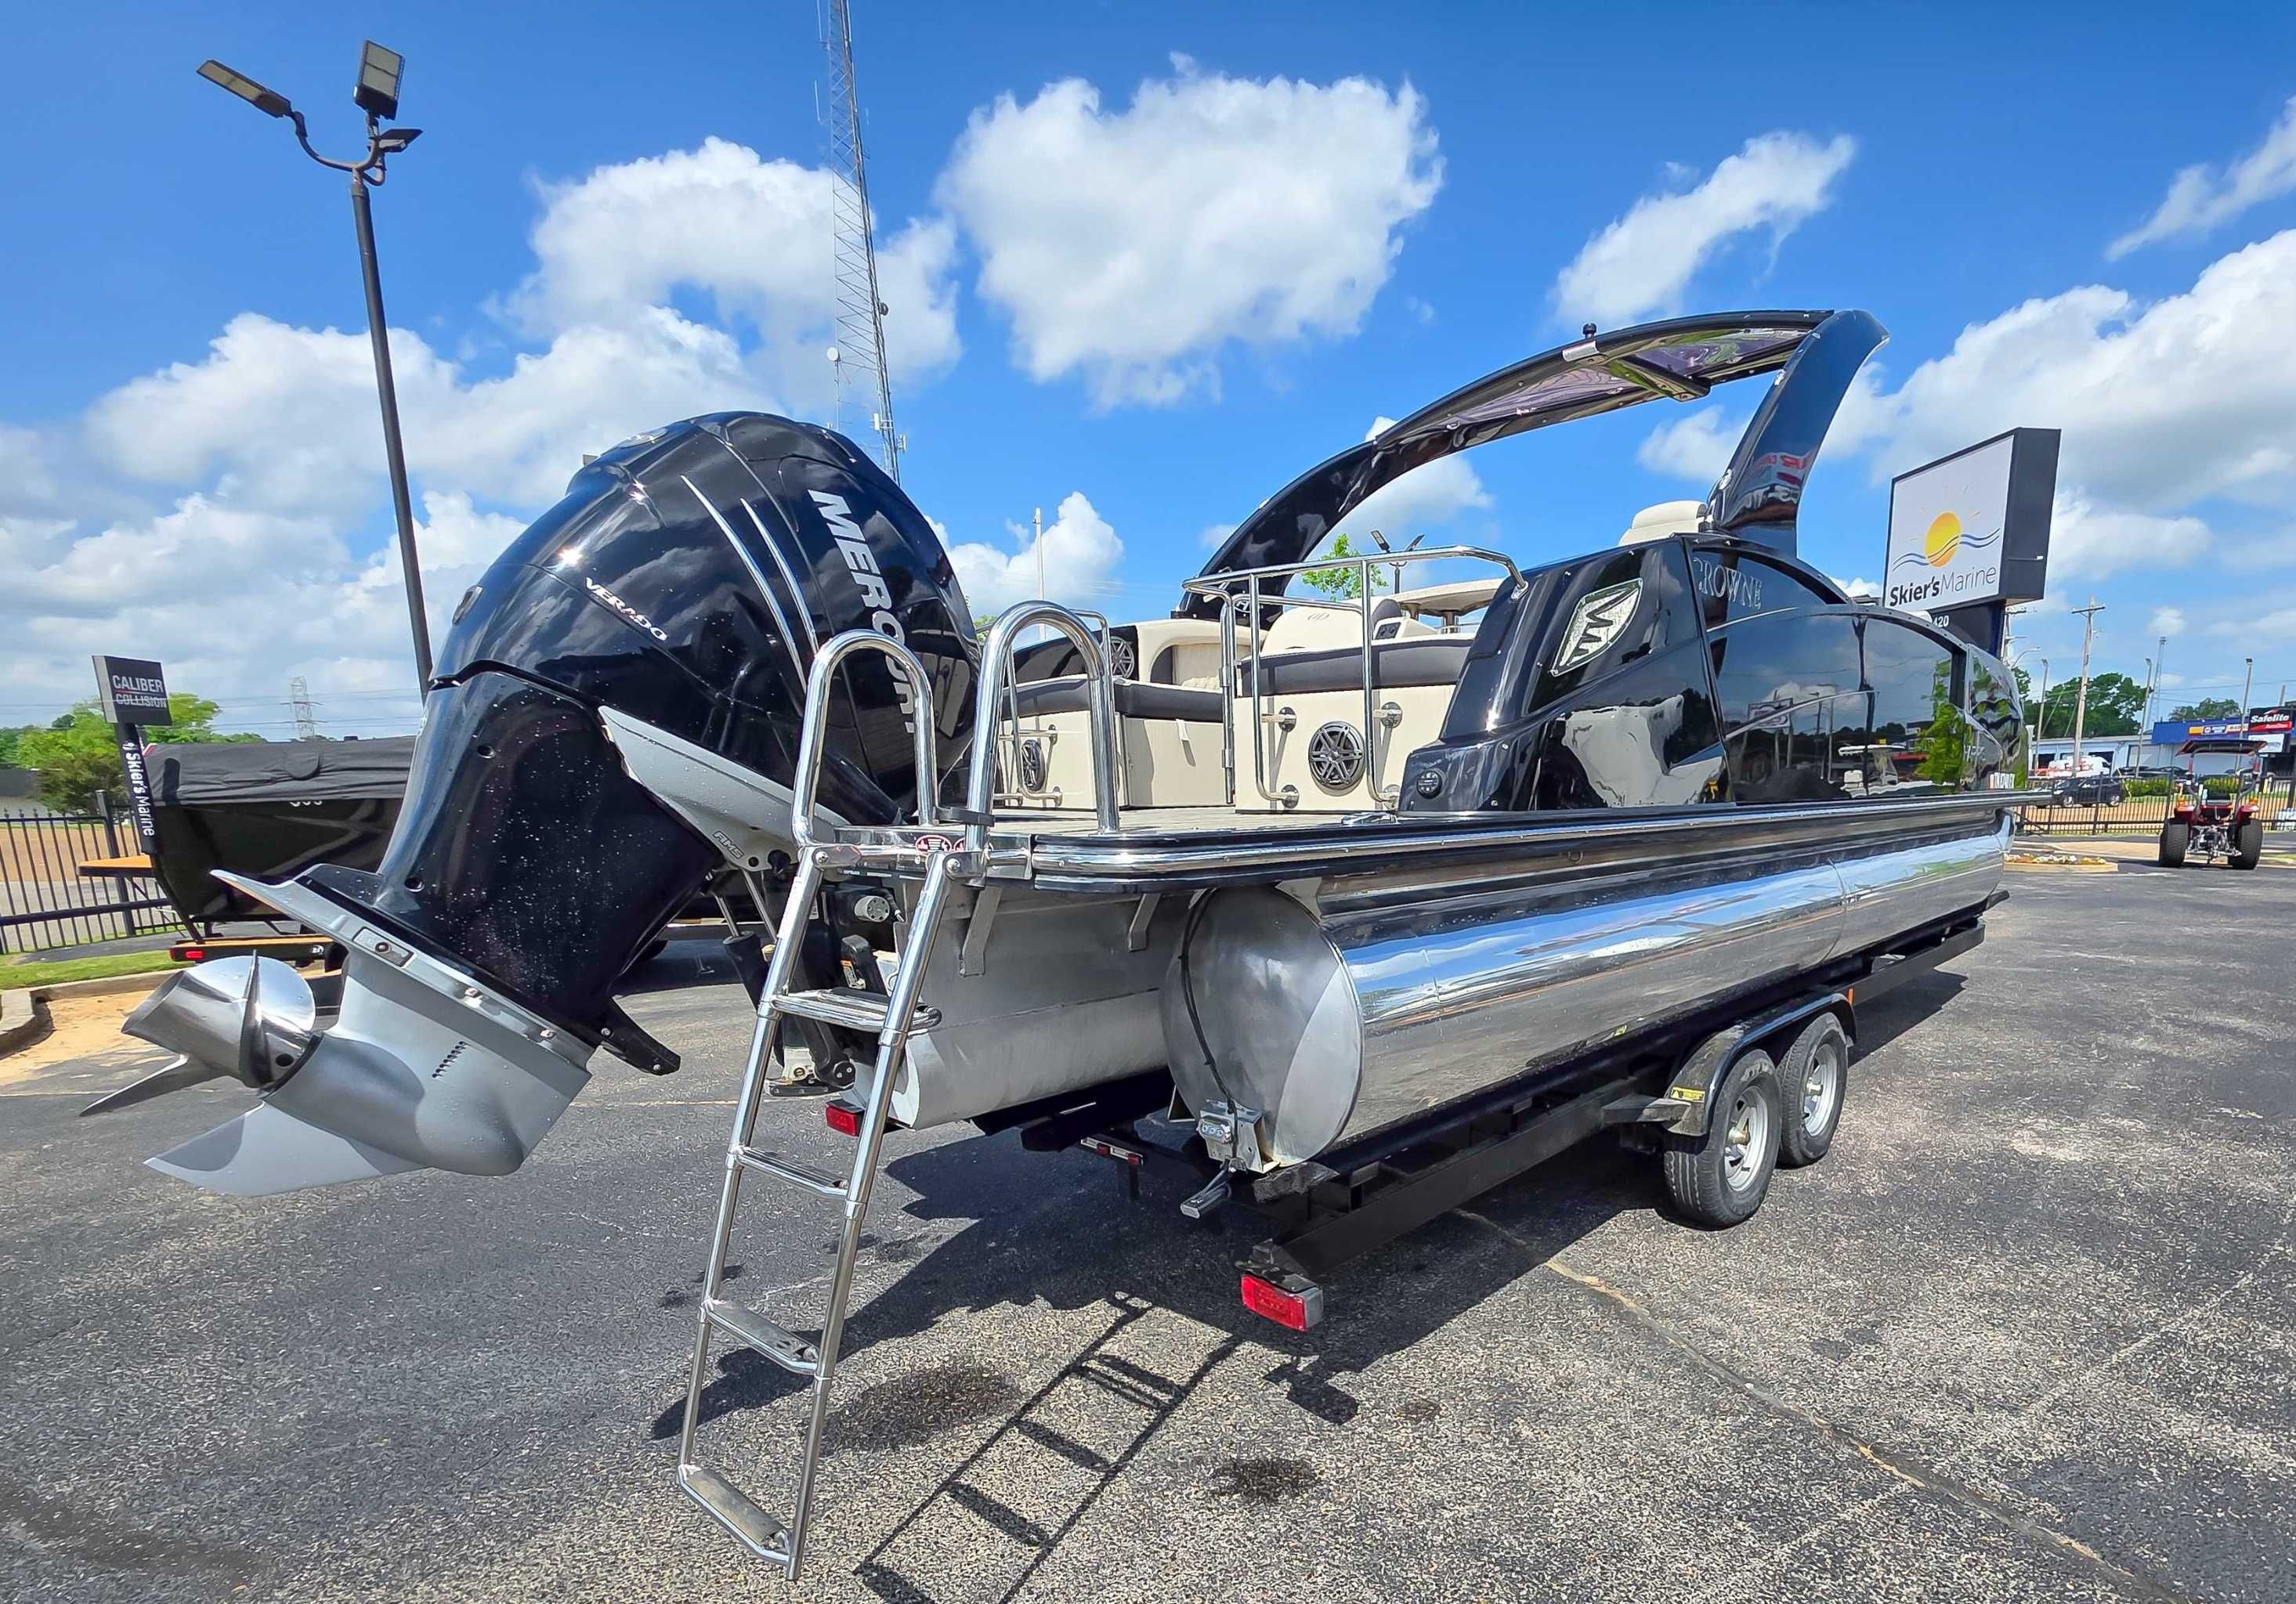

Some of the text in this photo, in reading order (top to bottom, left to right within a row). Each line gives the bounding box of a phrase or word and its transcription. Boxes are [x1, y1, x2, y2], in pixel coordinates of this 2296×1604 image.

[1889, 566, 1997, 606] Skier's Marine
[586, 576, 667, 641] VERADO
[112, 675, 164, 692] CALIBER
[116, 694, 167, 708] COLLISION
[125, 752, 155, 836] Skier's Marine
